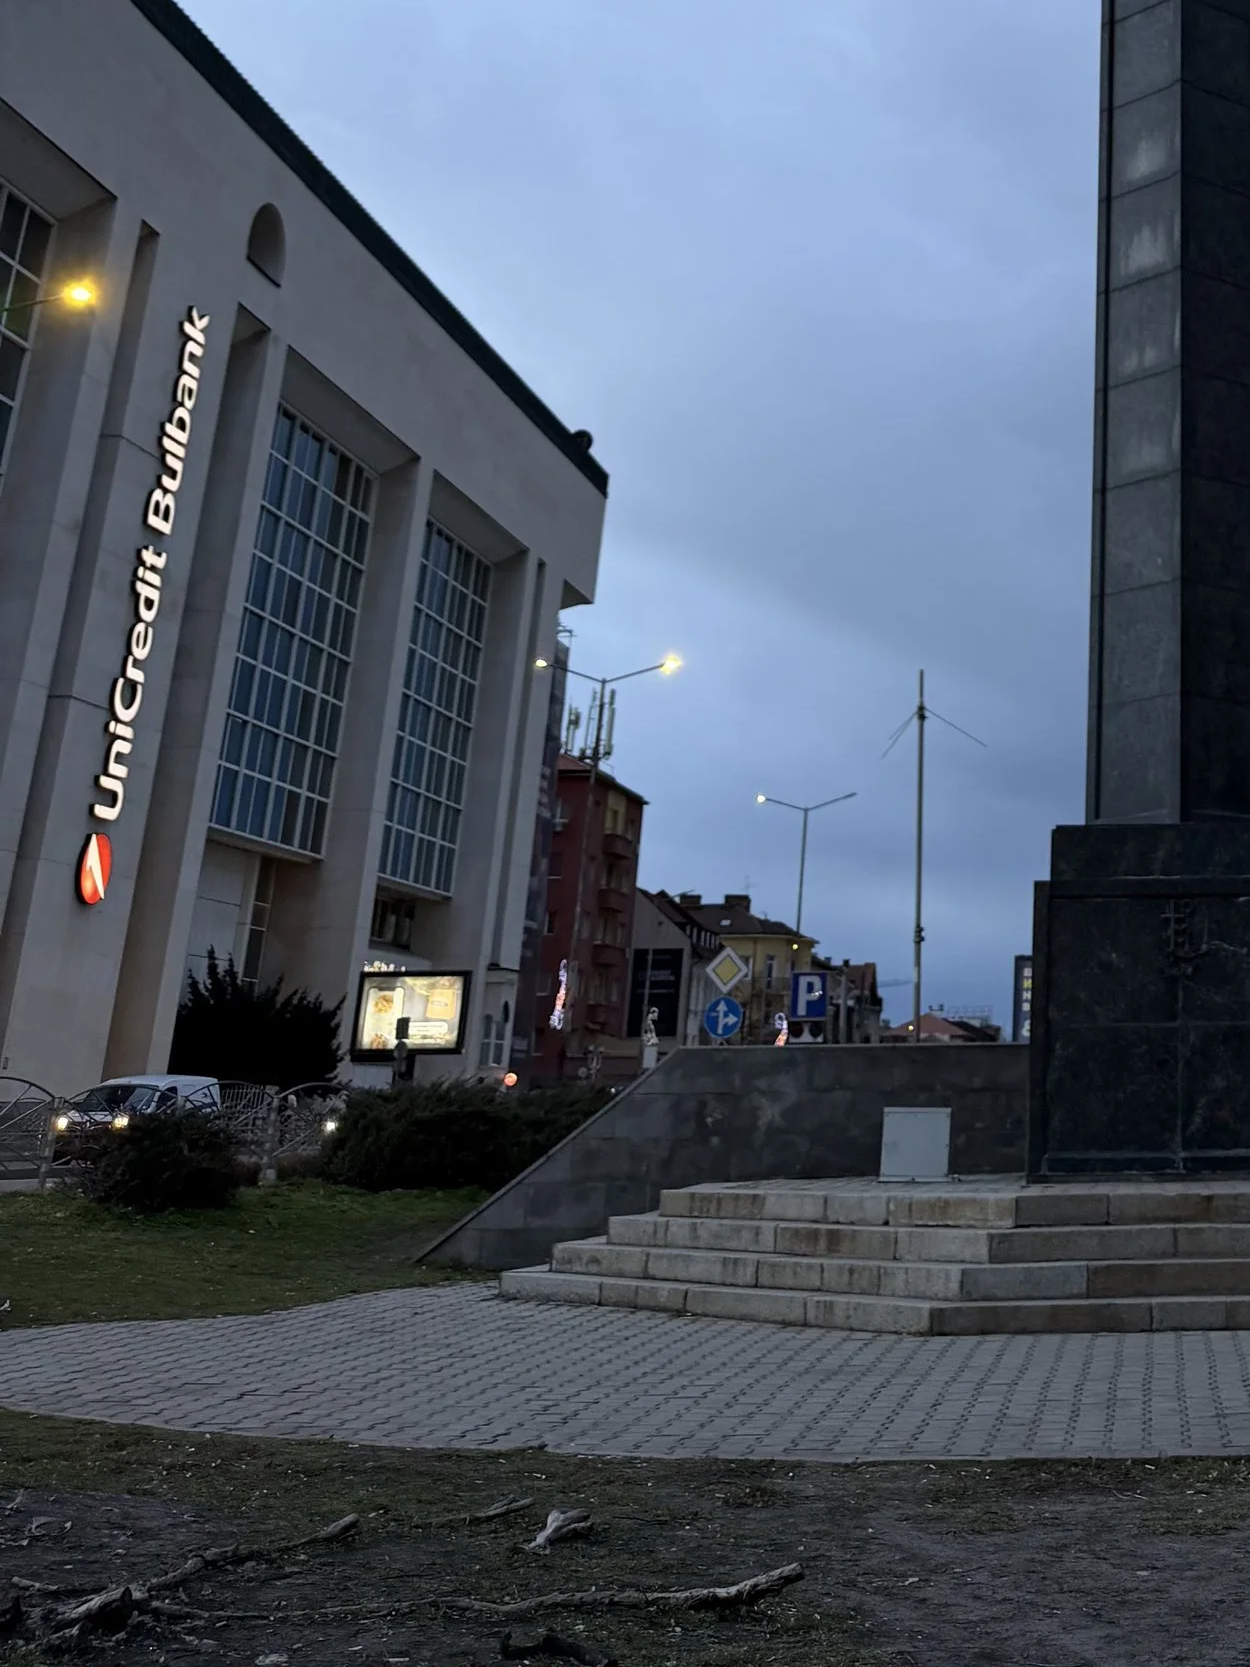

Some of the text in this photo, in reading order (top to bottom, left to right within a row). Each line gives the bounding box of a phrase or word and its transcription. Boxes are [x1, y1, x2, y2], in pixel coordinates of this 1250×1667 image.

[92, 306, 211, 821] UniCredit Bulbank
[797, 975, 823, 1016] P
